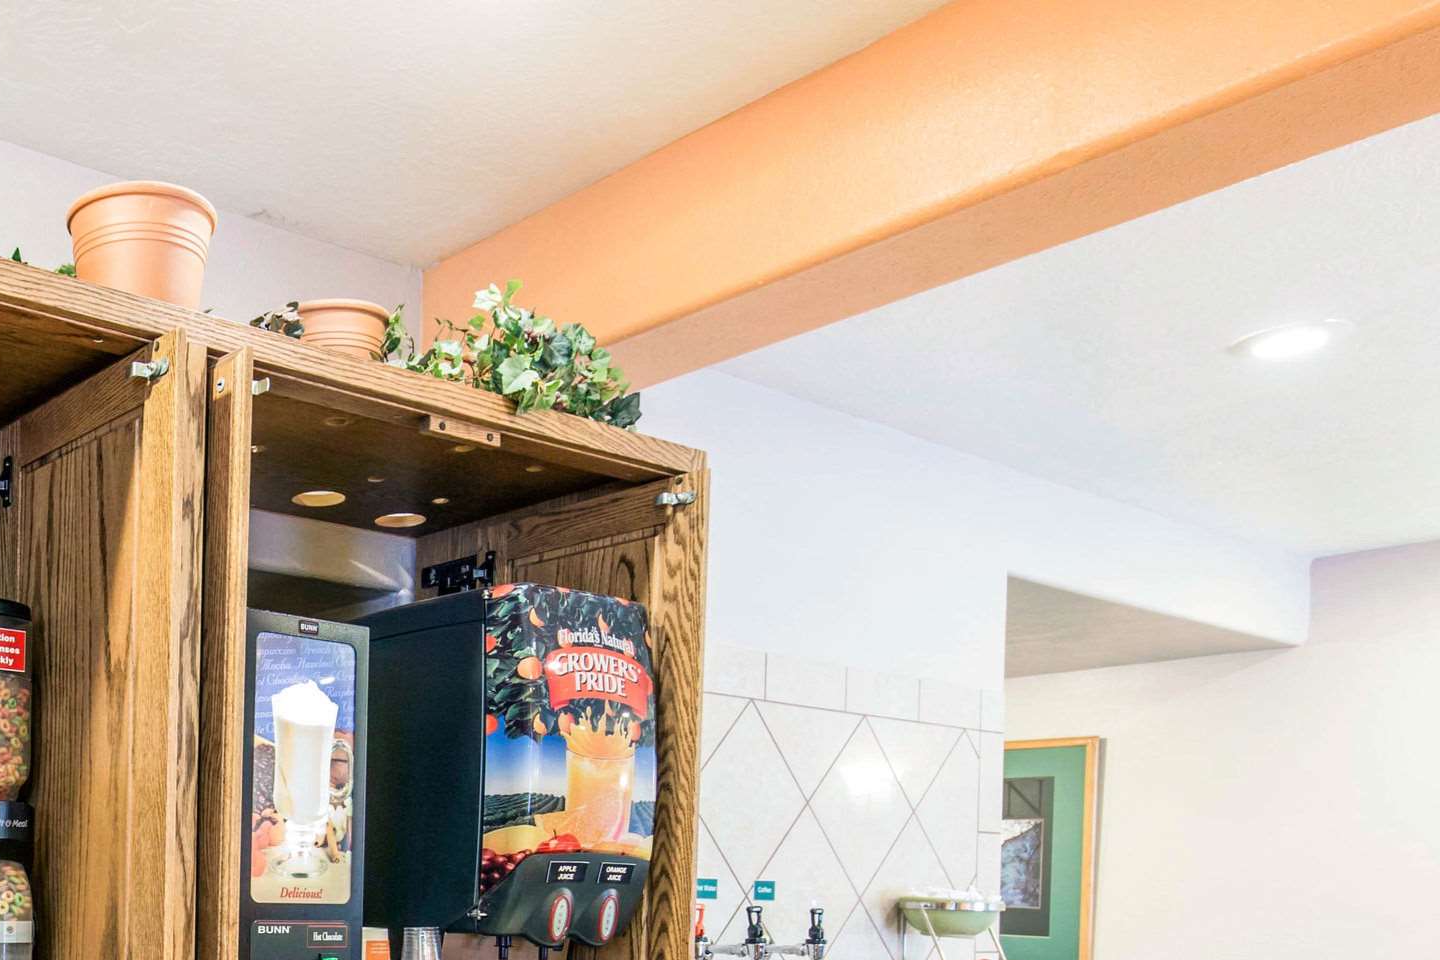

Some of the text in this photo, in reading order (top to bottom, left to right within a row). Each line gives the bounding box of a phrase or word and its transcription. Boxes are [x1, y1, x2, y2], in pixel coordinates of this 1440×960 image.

[559, 626, 635, 655] Florida's Natural
[575, 671, 627, 697] PRIDE
[558, 865, 577, 873] APPLE
[605, 866, 627, 874] ORANGE
[279, 886, 324, 899] Delicious!
[257, 925, 291, 934] BUNN
[313, 931, 343, 941] Hot Chocolate
